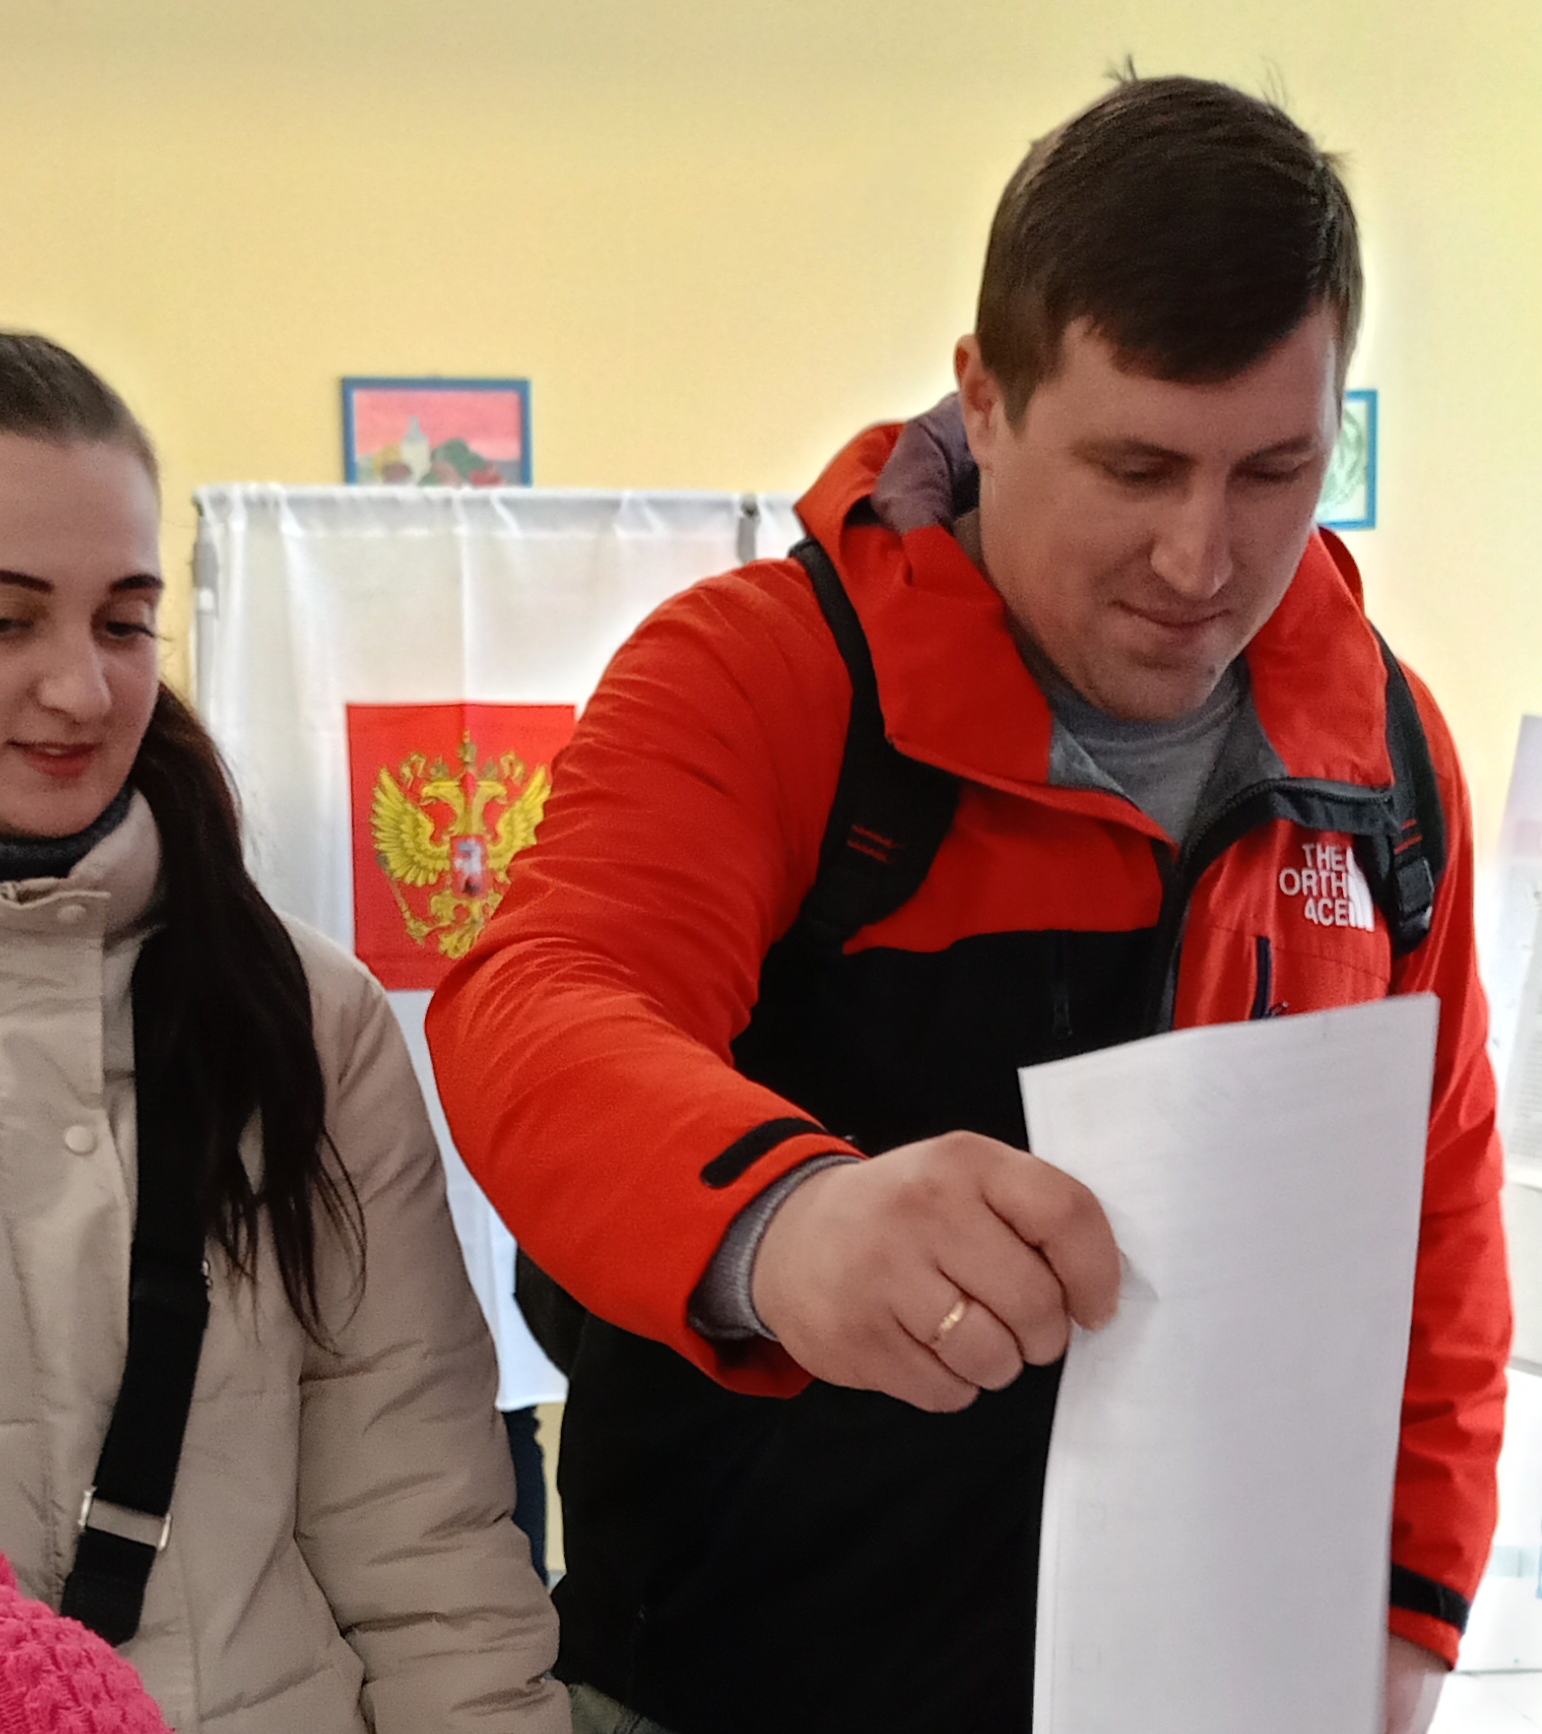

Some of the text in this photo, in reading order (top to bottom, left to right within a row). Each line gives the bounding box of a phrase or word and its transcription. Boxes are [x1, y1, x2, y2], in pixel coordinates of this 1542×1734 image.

[1302, 843, 1345, 870] THE
[1279, 868, 1348, 898] ORTH
[1304, 898, 1349, 926] ACE
